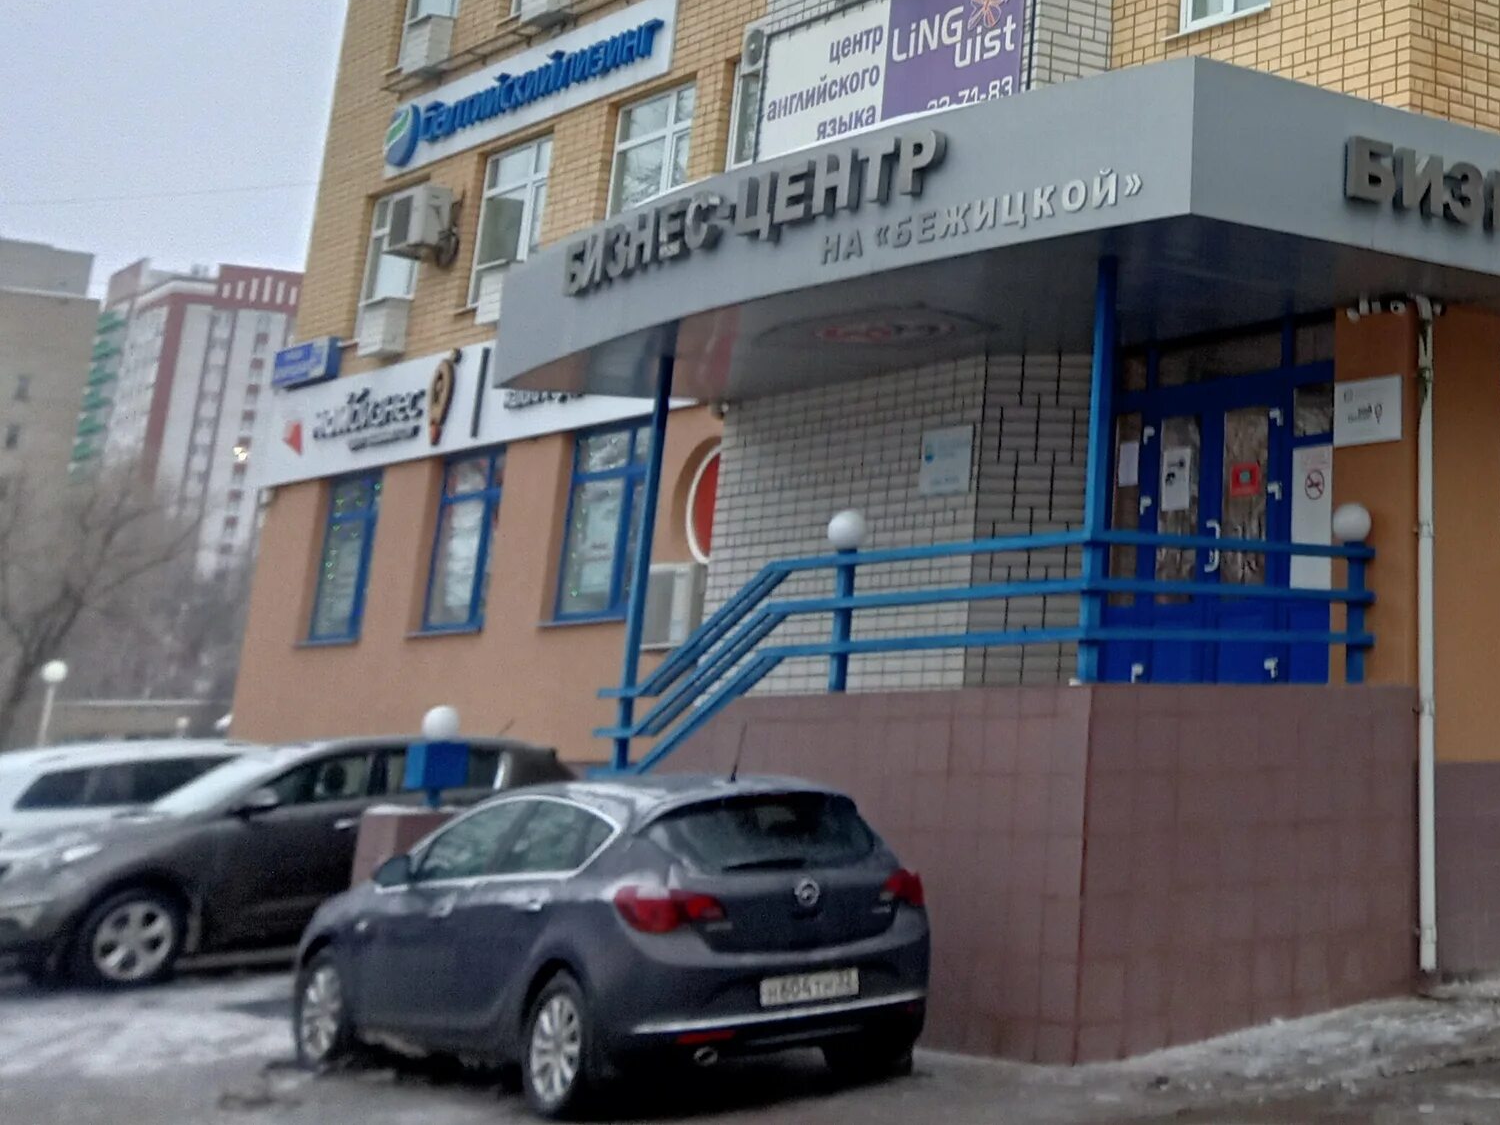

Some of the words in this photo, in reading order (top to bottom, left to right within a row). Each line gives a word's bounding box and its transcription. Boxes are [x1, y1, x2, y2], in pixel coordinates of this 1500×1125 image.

[829, 24, 884, 64] центр
[766, 64, 880, 122] английского
[816, 104, 876, 141] языка
[563, 129, 947, 297] БИЗНЕС-ЦЕНТР
[820, 231, 864, 266] НА
[876, 167, 1144, 249] «БЕЖИЦКОЙ»
